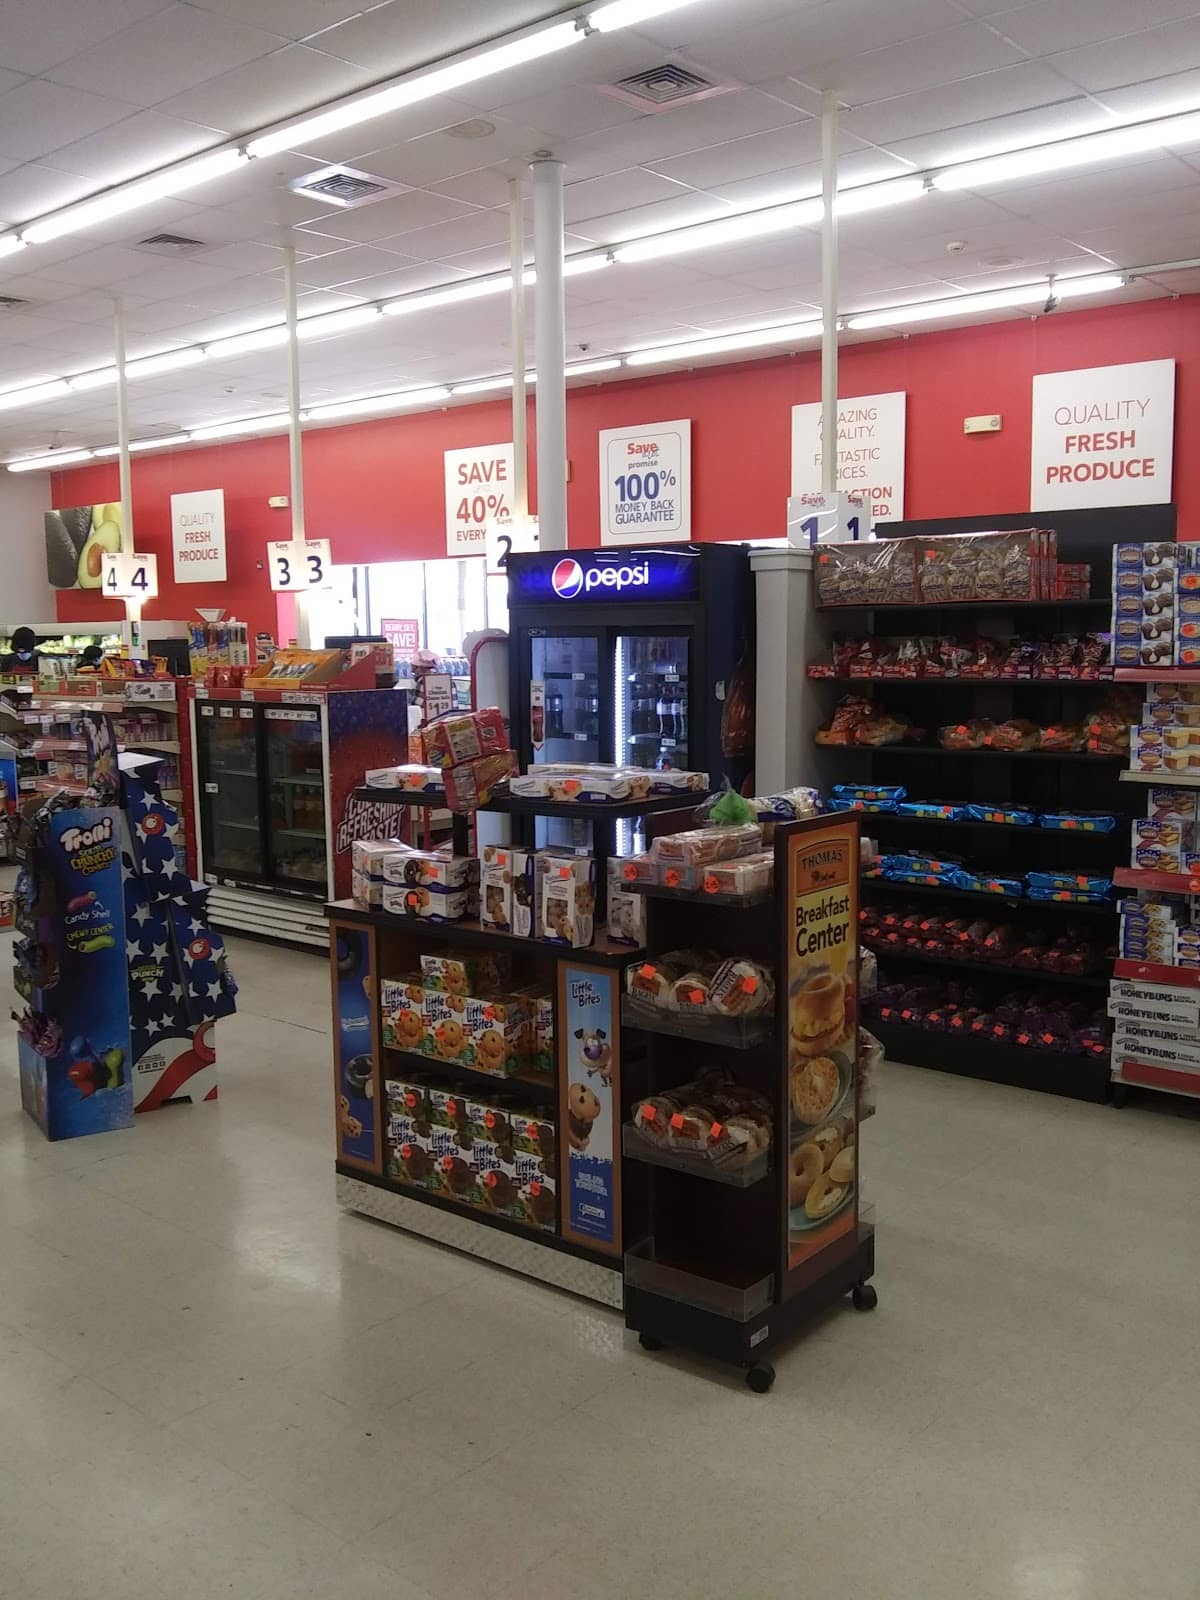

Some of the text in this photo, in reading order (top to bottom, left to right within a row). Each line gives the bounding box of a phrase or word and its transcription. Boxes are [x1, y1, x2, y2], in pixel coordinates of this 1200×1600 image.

[818, 408, 877, 425] AAZING
[1054, 399, 1151, 426] QUALITY
[627, 442, 658, 454] Save
[1064, 430, 1137, 454] FRESH
[458, 459, 507, 485] SAVE
[628, 460, 658, 470] promise
[1046, 458, 1156, 484] PRODUCE
[614, 468, 676, 502] 100%
[456, 493, 510, 523] 40%
[615, 499, 674, 513] MONEY BACK
[180, 512, 216, 526] QUALITY
[615, 509, 675, 525] GUARANTEE
[800, 516, 818, 550] 1
[847, 516, 859, 541] 1
[185, 531, 211, 544] FRESH
[179, 548, 219, 562] PRODUCE
[497, 535, 512, 568] 2
[277, 557, 291, 586] 3
[307, 555, 323, 584] 3
[585, 562, 649, 592] pepsi
[107, 567, 117, 592] 4
[131, 567, 149, 591] 4
[60, 818, 112, 852] Trolli
[65, 911, 89, 925] Candy
[796, 895, 850, 927] Breakfast
[796, 922, 850, 957] Center
[131, 968, 165, 981] PUNCH
[390, 1000, 411, 1013] Bites
[578, 994, 601, 1007] Bites
[431, 1010, 453, 1022] Bites
[472, 1019, 494, 1032] Bites
[397, 1132, 417, 1144] Bites
[436, 1145, 459, 1158] Bites
[479, 1158, 501, 1170] Bites
[521, 1173, 545, 1185] Bites
